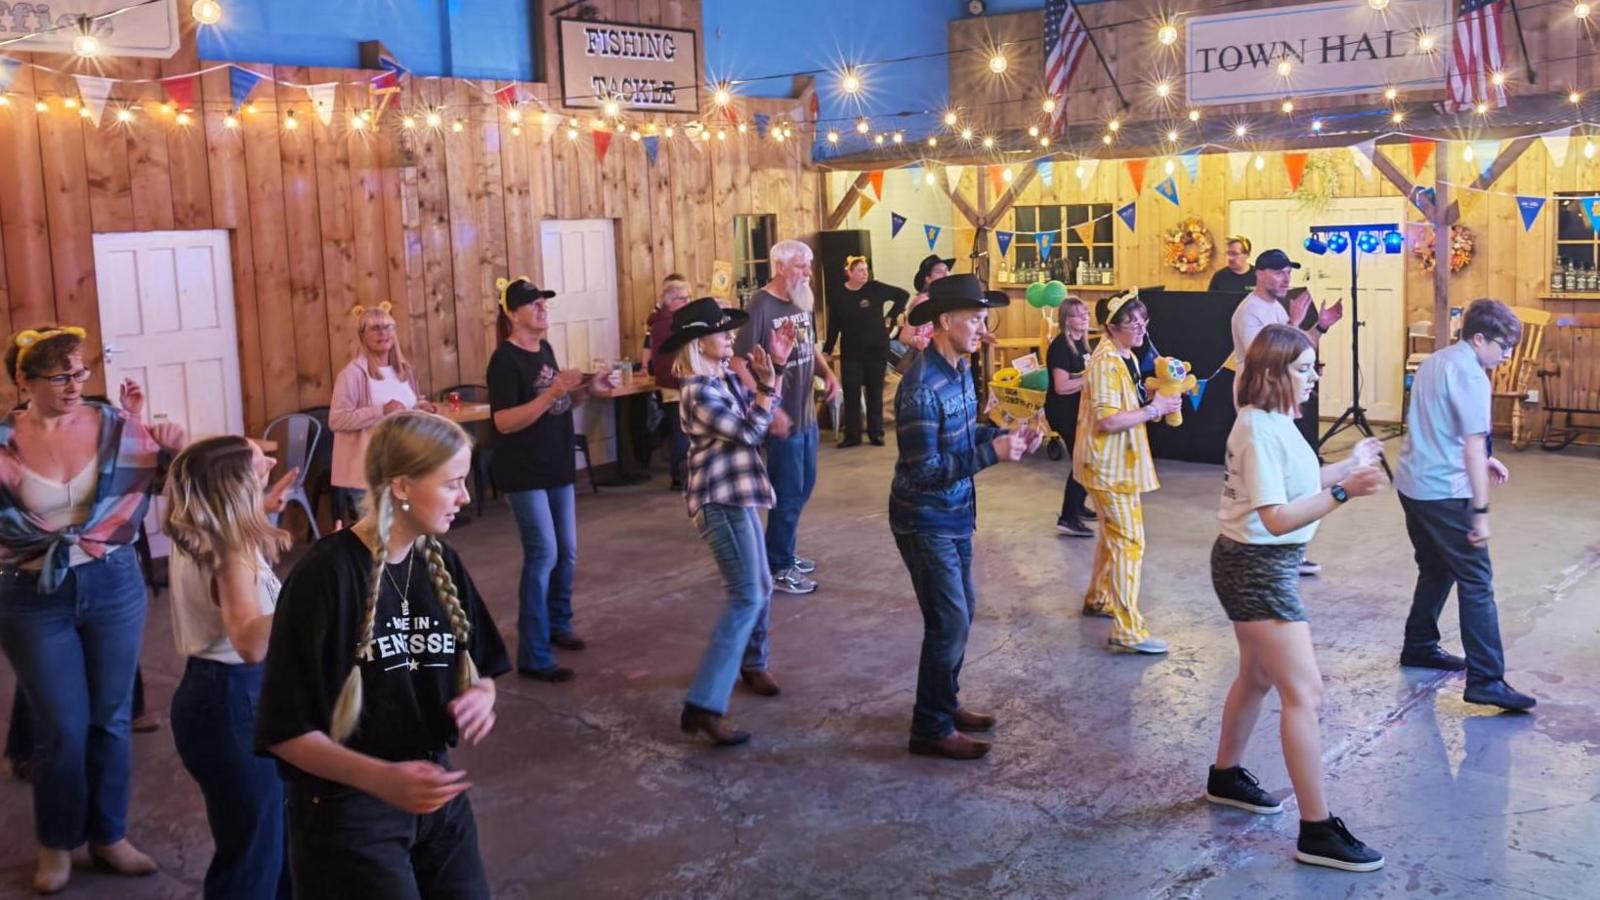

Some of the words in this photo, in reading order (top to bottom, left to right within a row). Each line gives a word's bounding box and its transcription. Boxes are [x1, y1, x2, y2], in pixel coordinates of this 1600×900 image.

[585, 27, 677, 60] FISHING
[1196, 39, 1308, 73] TOWN
[1319, 26, 1438, 63] HAL
[592, 76, 676, 105] TACKLE
[414, 616, 430, 630] IN
